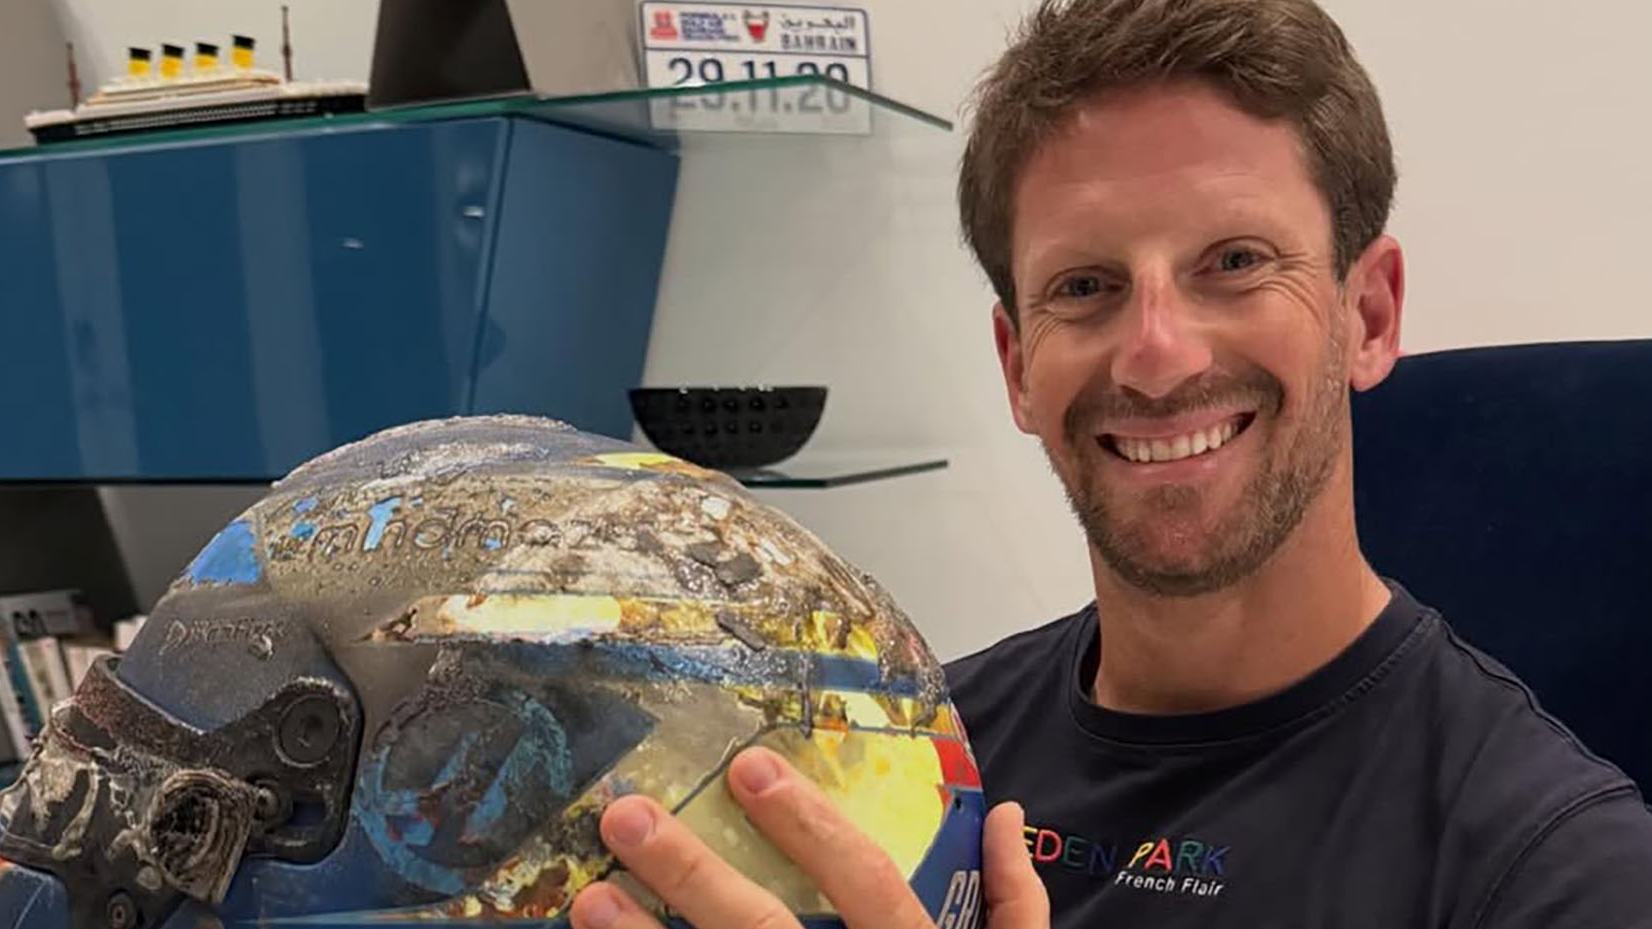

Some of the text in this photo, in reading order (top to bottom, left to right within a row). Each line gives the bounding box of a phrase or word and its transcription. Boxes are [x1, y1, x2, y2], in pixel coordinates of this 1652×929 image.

[780, 33, 857, 51] BAHRAIN
[668, 57, 851, 114] 29.11.20
[1128, 837, 1231, 876] PARK
[1114, 870, 1225, 897] French Flair
